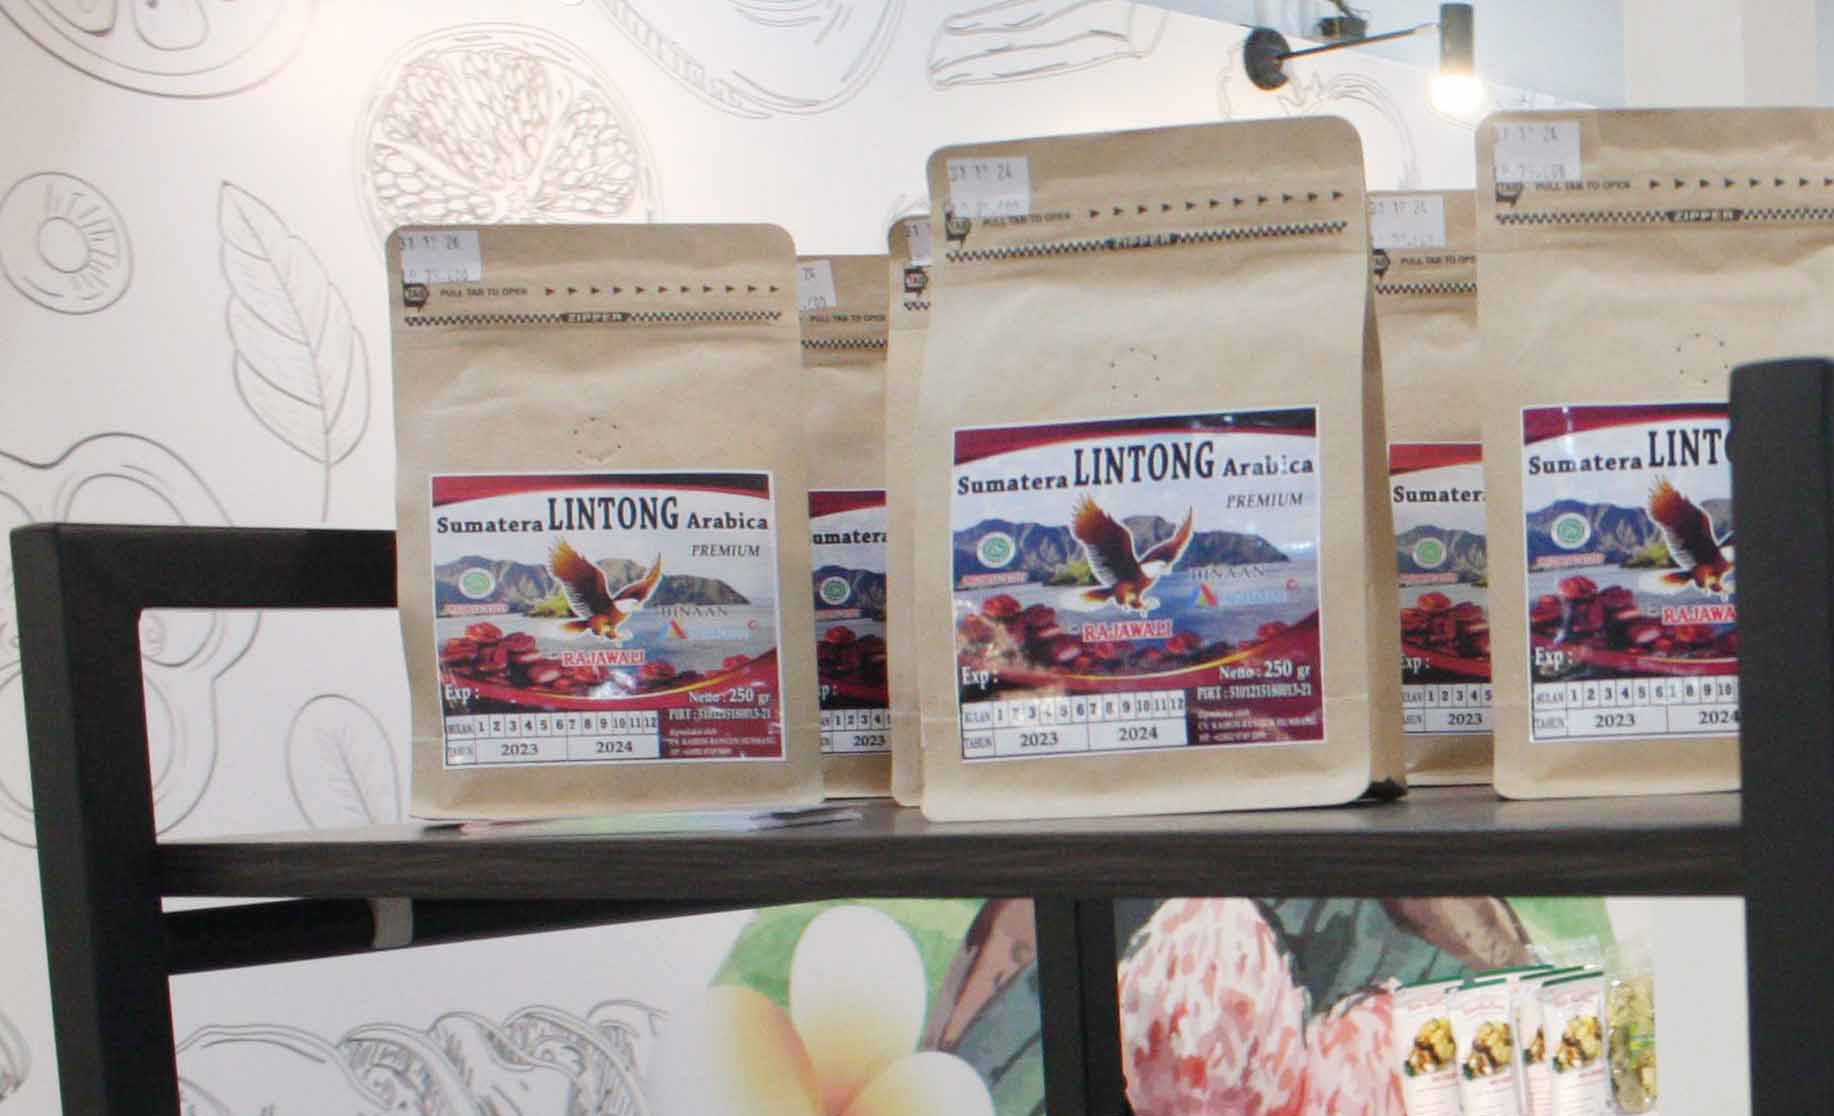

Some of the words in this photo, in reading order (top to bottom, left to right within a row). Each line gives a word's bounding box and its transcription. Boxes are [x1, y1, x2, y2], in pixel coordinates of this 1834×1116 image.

[1528, 455, 1641, 475] Sumatera
[1648, 429, 1731, 467] LINT
[958, 475, 1067, 495] Sumatera
[1074, 441, 1213, 486] LINTONG
[1223, 455, 1314, 476] Arabica
[1227, 493, 1303, 509] PREMIUM
[1393, 485, 1486, 503] Sumater
[437, 516, 543, 533] Sumatera
[548, 496, 678, 531] LINTONG
[687, 512, 768, 530] Arabica
[813, 530, 887, 544] umater
[692, 544, 760, 558] PREMIUM
[1663, 605, 1736, 624] RAJAWA
[1083, 620, 1171, 642] RAJAWALI
[562, 651, 645, 667] RAJAWALI
[1535, 647, 1564, 669] Exp
[1263, 659, 1293, 678] 250
[729, 687, 754, 703] 250
[1448, 712, 1483, 726] 2023
[1594, 713, 1636, 728] 2023
[853, 735, 886, 747] 2023
[1020, 732, 1059, 747] 2023
[1119, 728, 1158, 742] 2024
[501, 743, 539, 757] 2023
[596, 740, 633, 755] 2024
